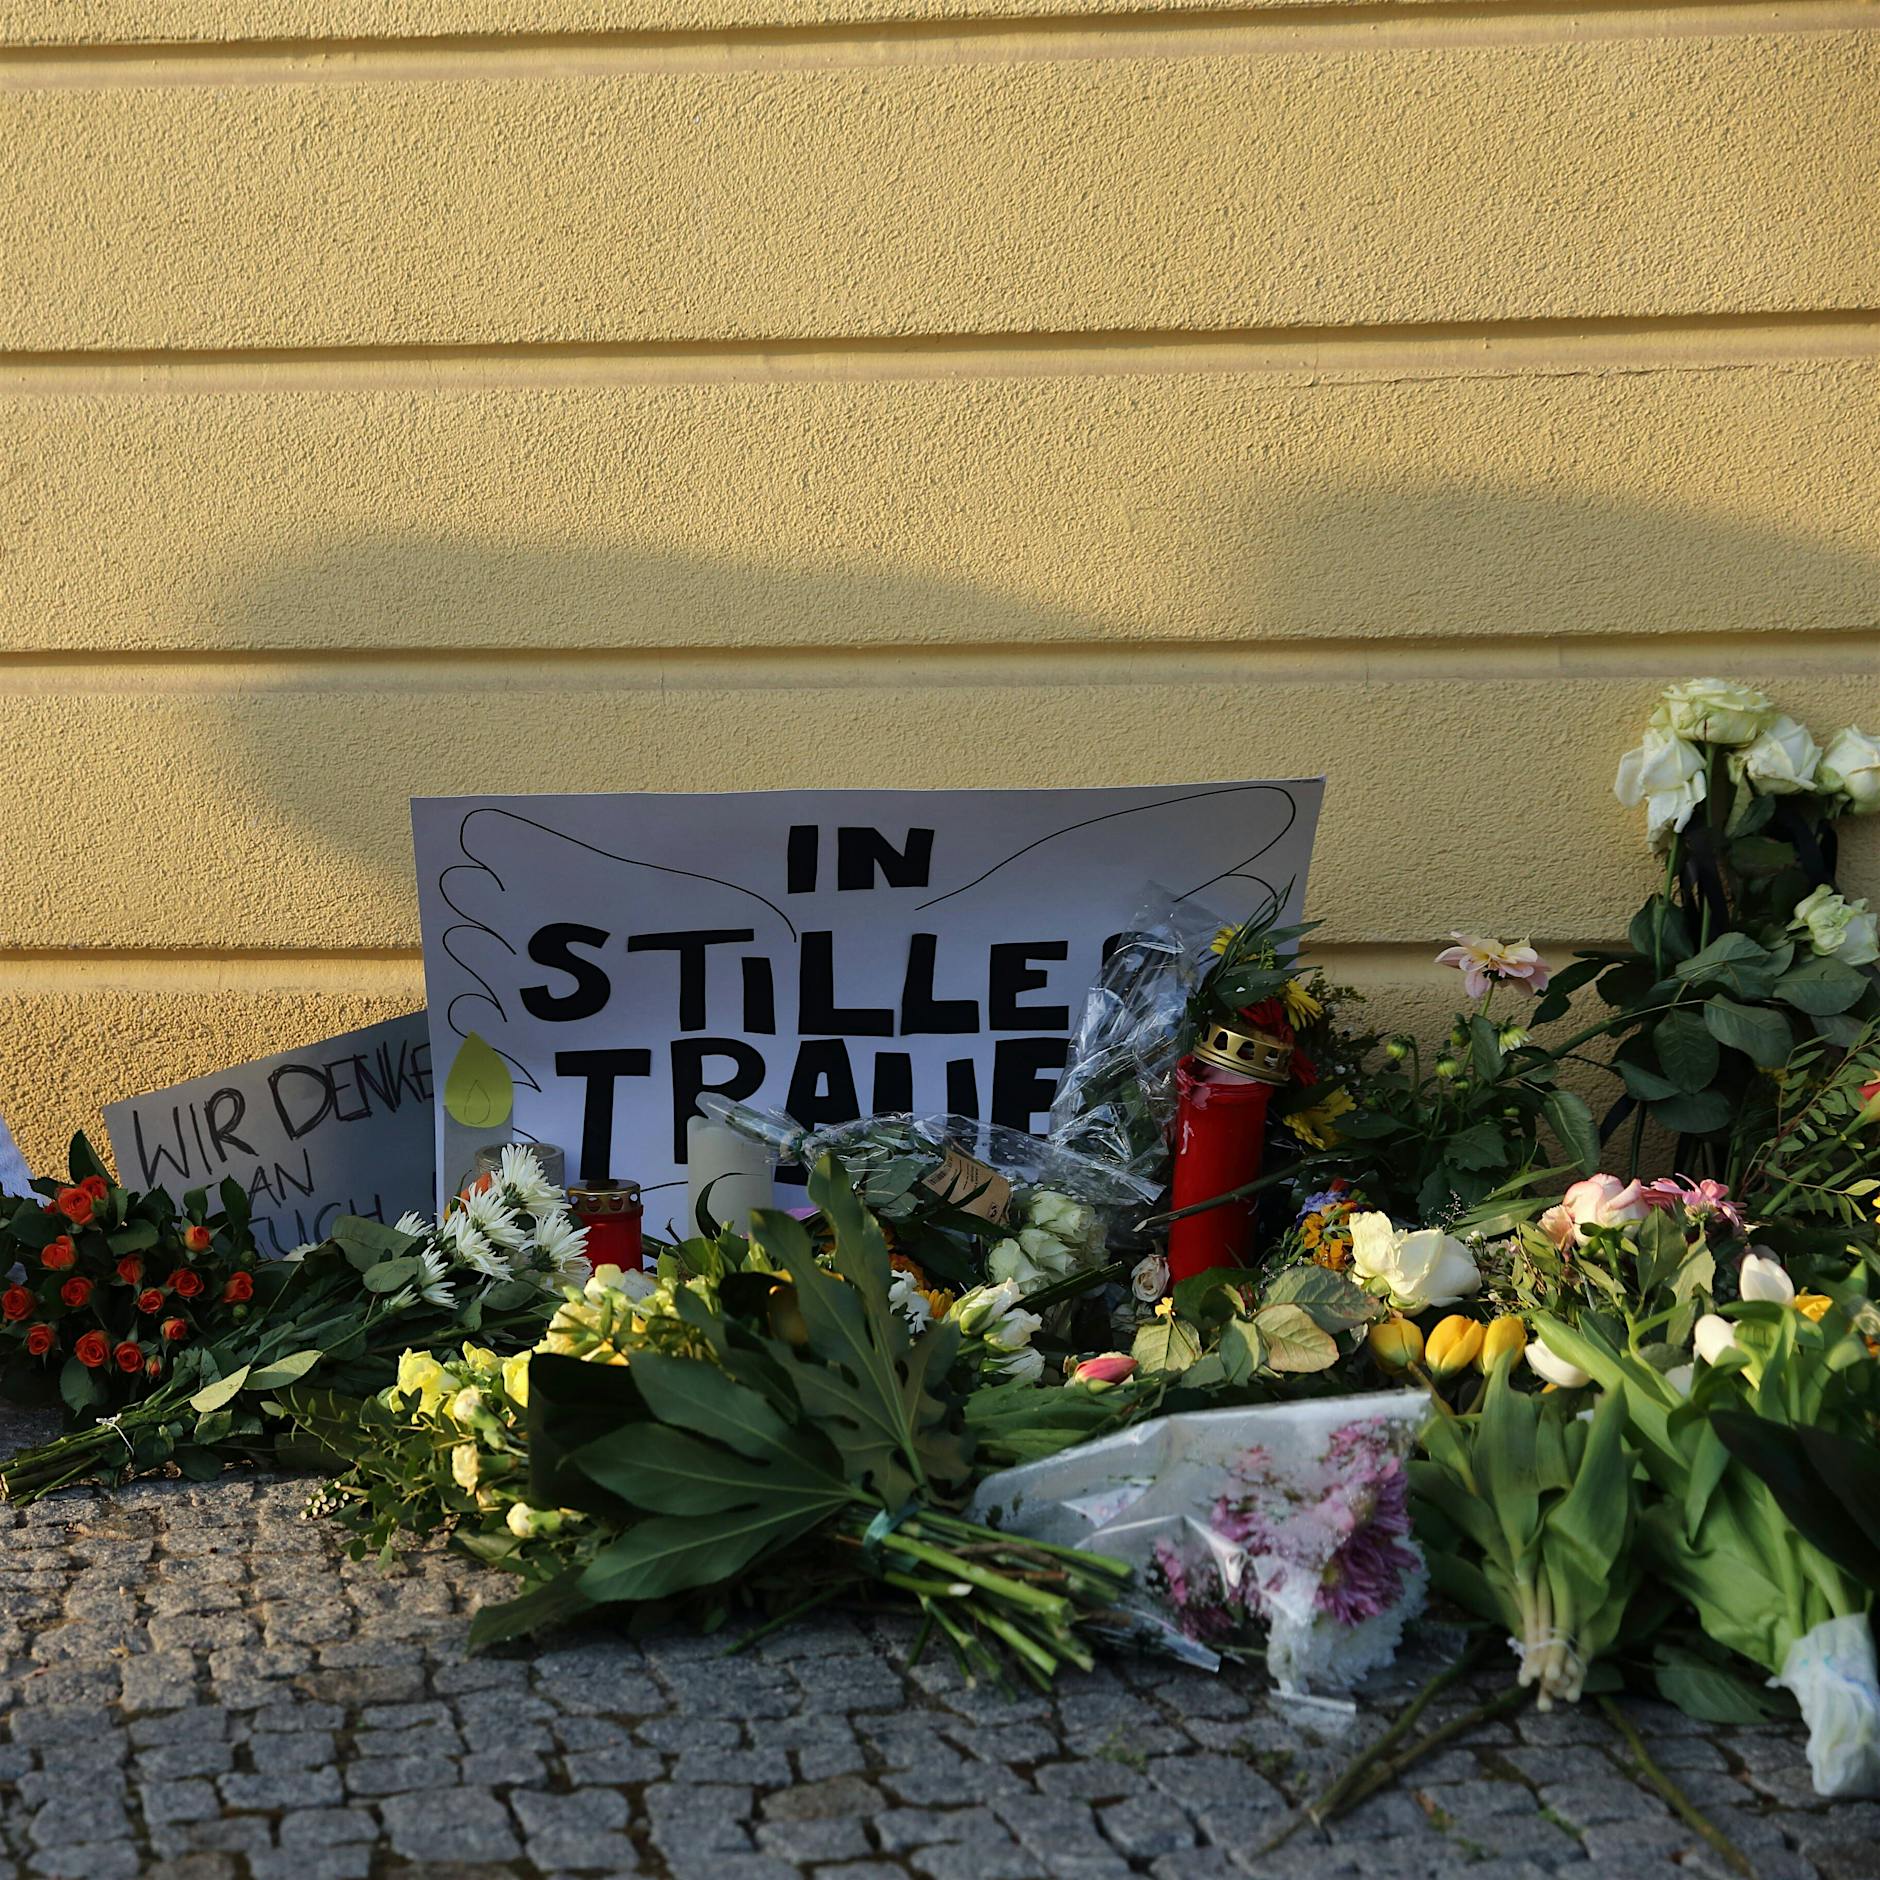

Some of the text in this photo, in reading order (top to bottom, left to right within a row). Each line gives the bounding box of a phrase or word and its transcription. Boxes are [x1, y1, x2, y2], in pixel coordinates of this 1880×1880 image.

[787, 825, 935, 894] IN
[133, 1088, 259, 1189] WIR
[248, 1149, 315, 1210] AN
